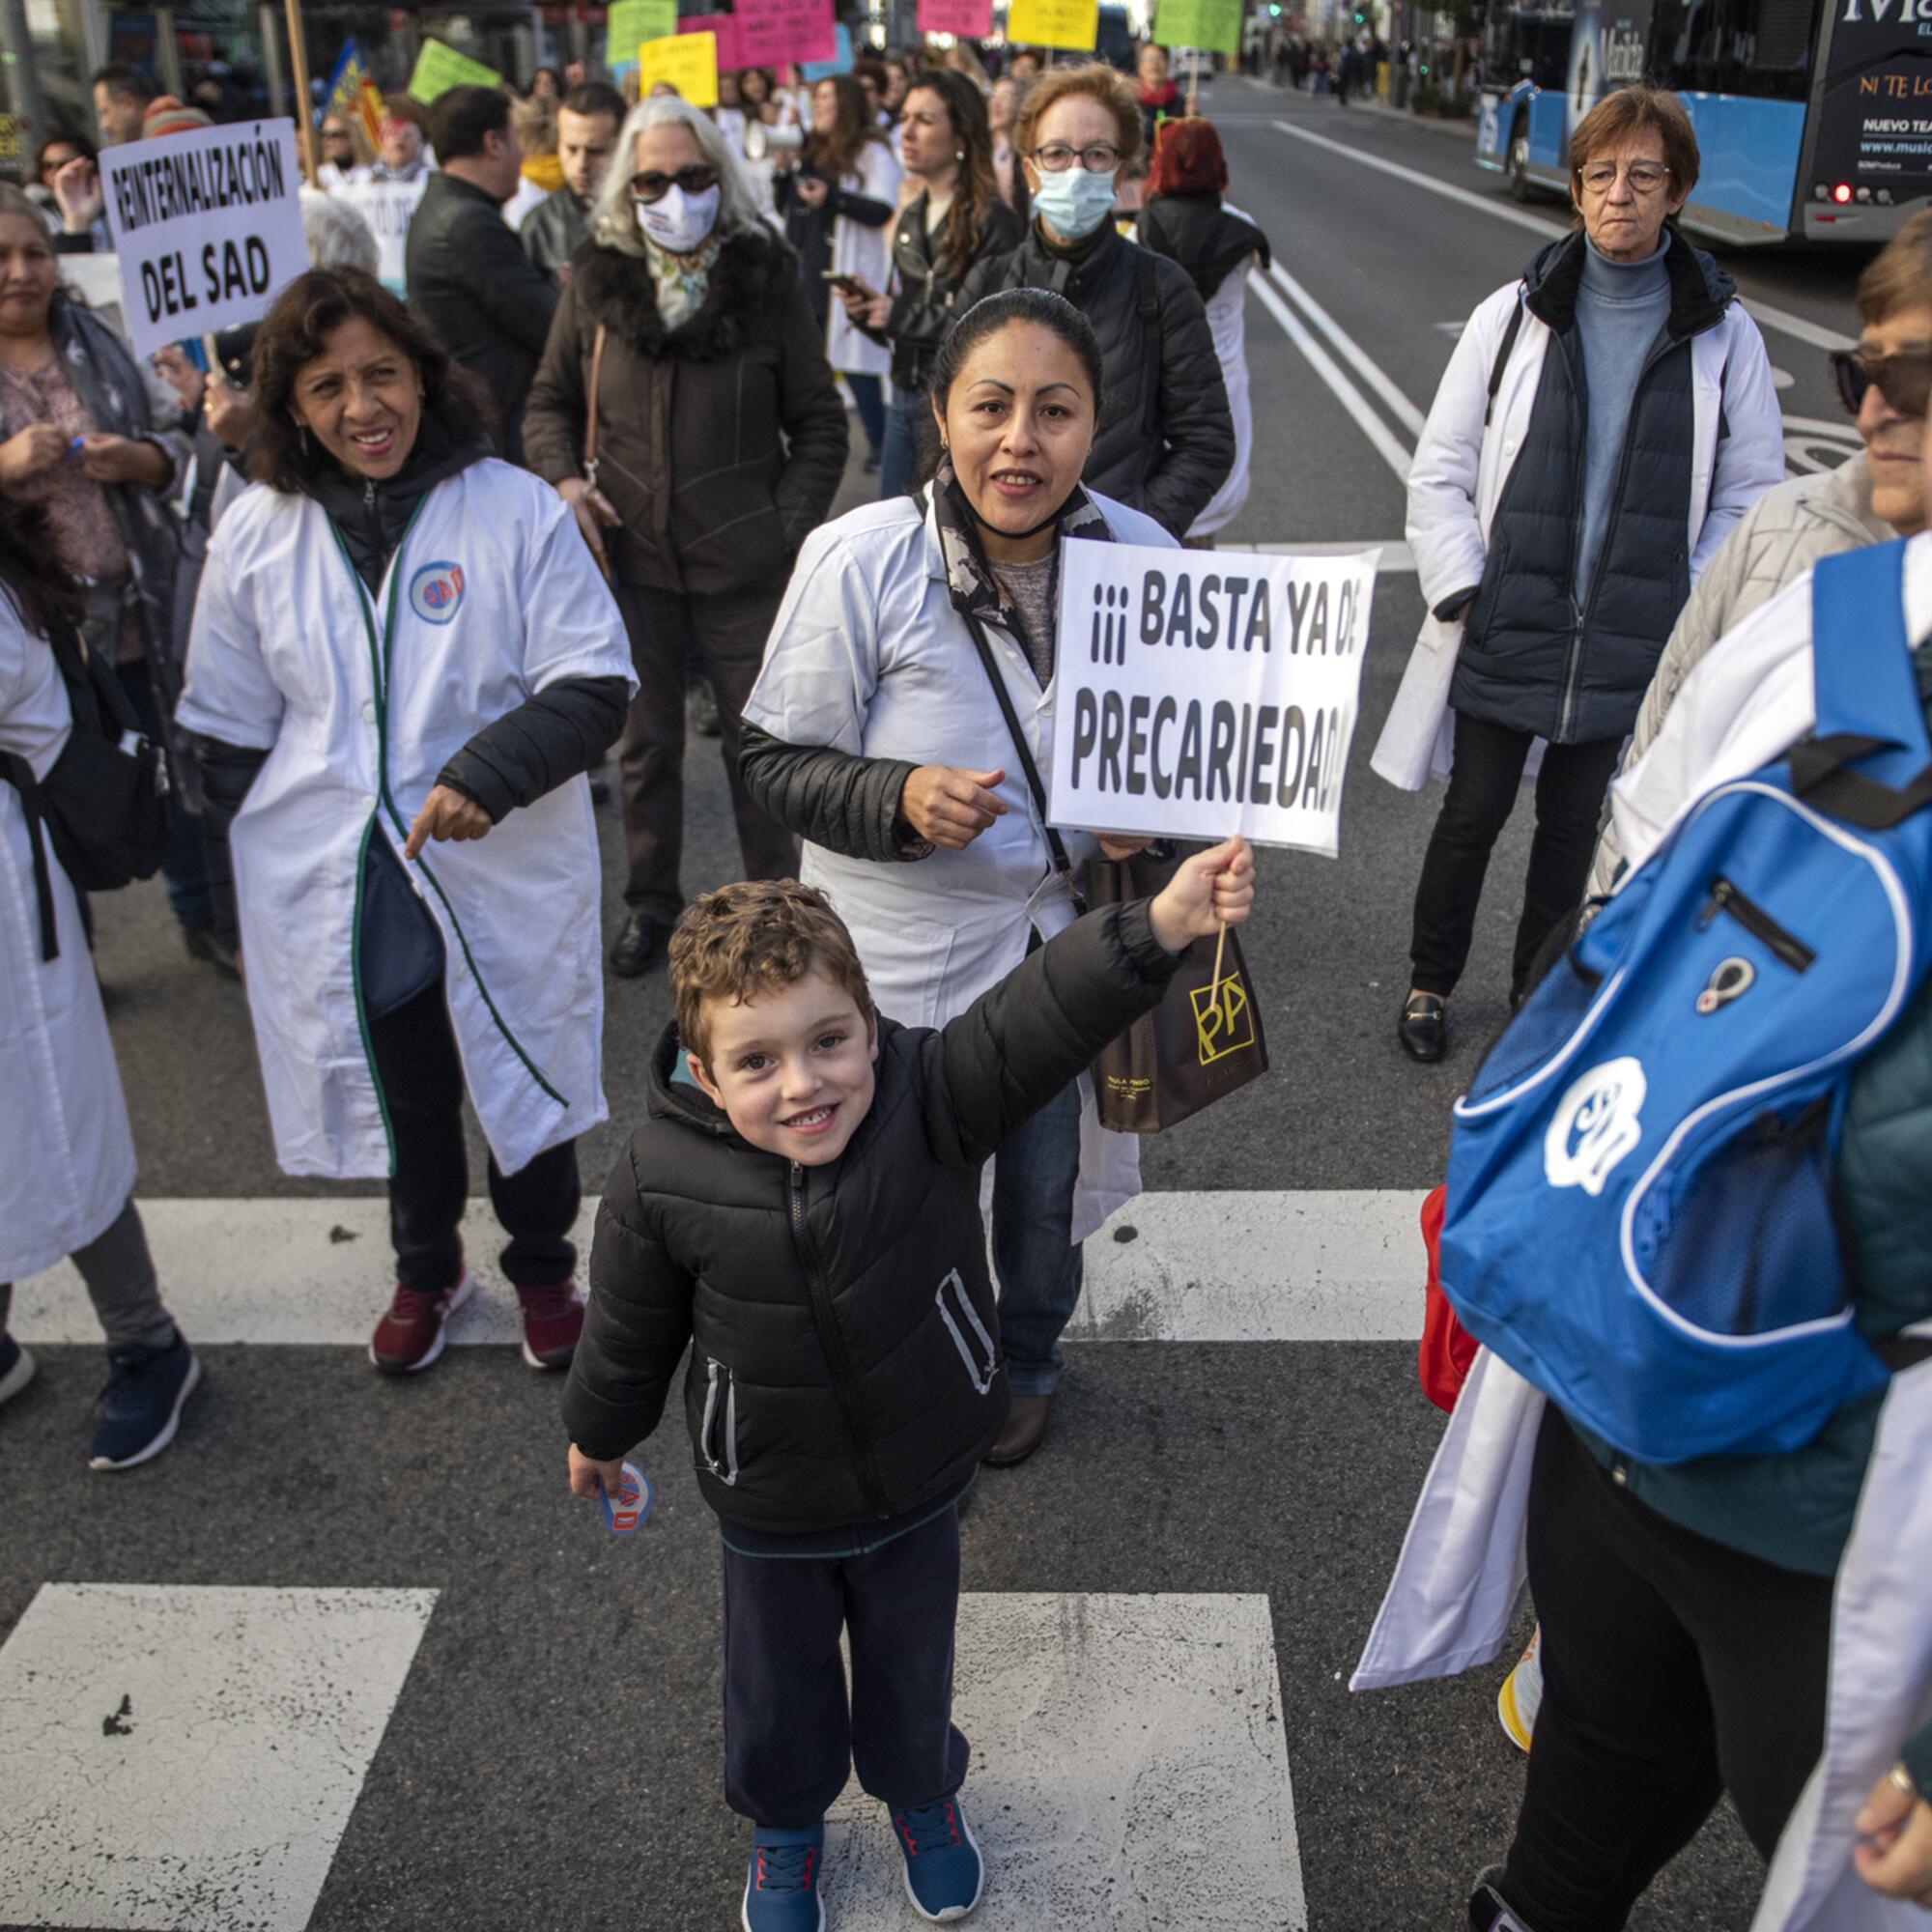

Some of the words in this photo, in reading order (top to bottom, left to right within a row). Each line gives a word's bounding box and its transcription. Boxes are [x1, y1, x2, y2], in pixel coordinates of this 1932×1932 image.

[1860, 76, 1879, 96] NI
[1885, 74, 1908, 99] TE
[1862, 119, 1910, 132] NUEVO
[112, 124, 286, 233] REINTERNALIZACIÓN
[141, 250, 198, 324] DEL
[202, 235, 270, 304] SAD
[1140, 569, 1271, 654] BASTA
[1287, 581, 1328, 656] YA
